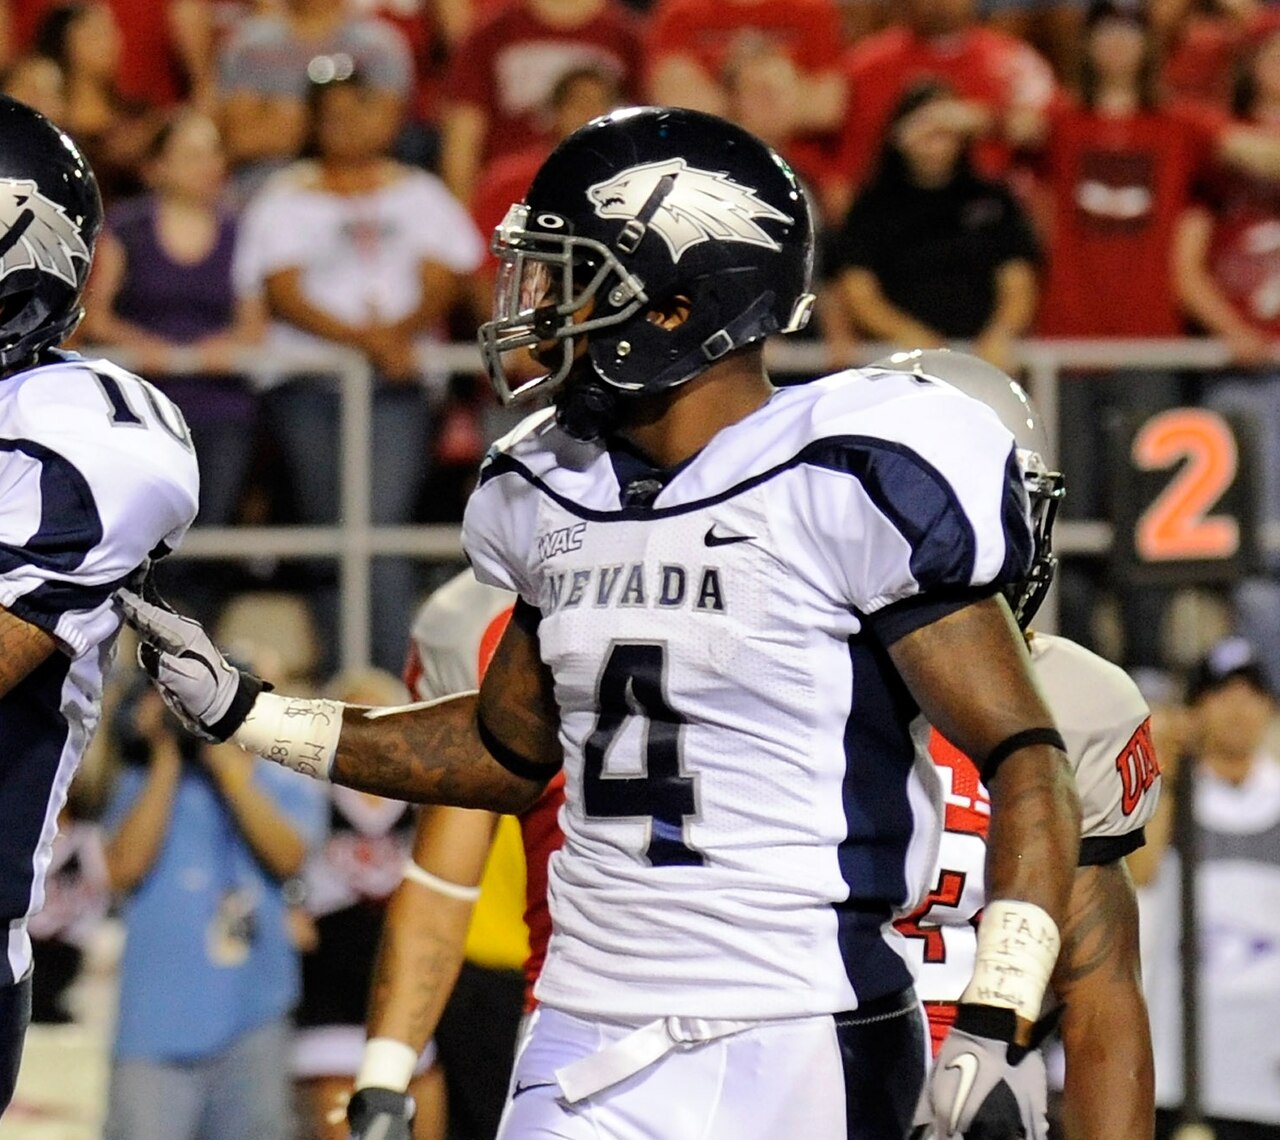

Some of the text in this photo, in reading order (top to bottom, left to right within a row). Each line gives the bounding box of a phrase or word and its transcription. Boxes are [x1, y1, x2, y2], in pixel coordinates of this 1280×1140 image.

[1131, 407, 1241, 563] 2
[542, 563, 726, 614] NEVADA
[582, 638, 705, 868] 4
